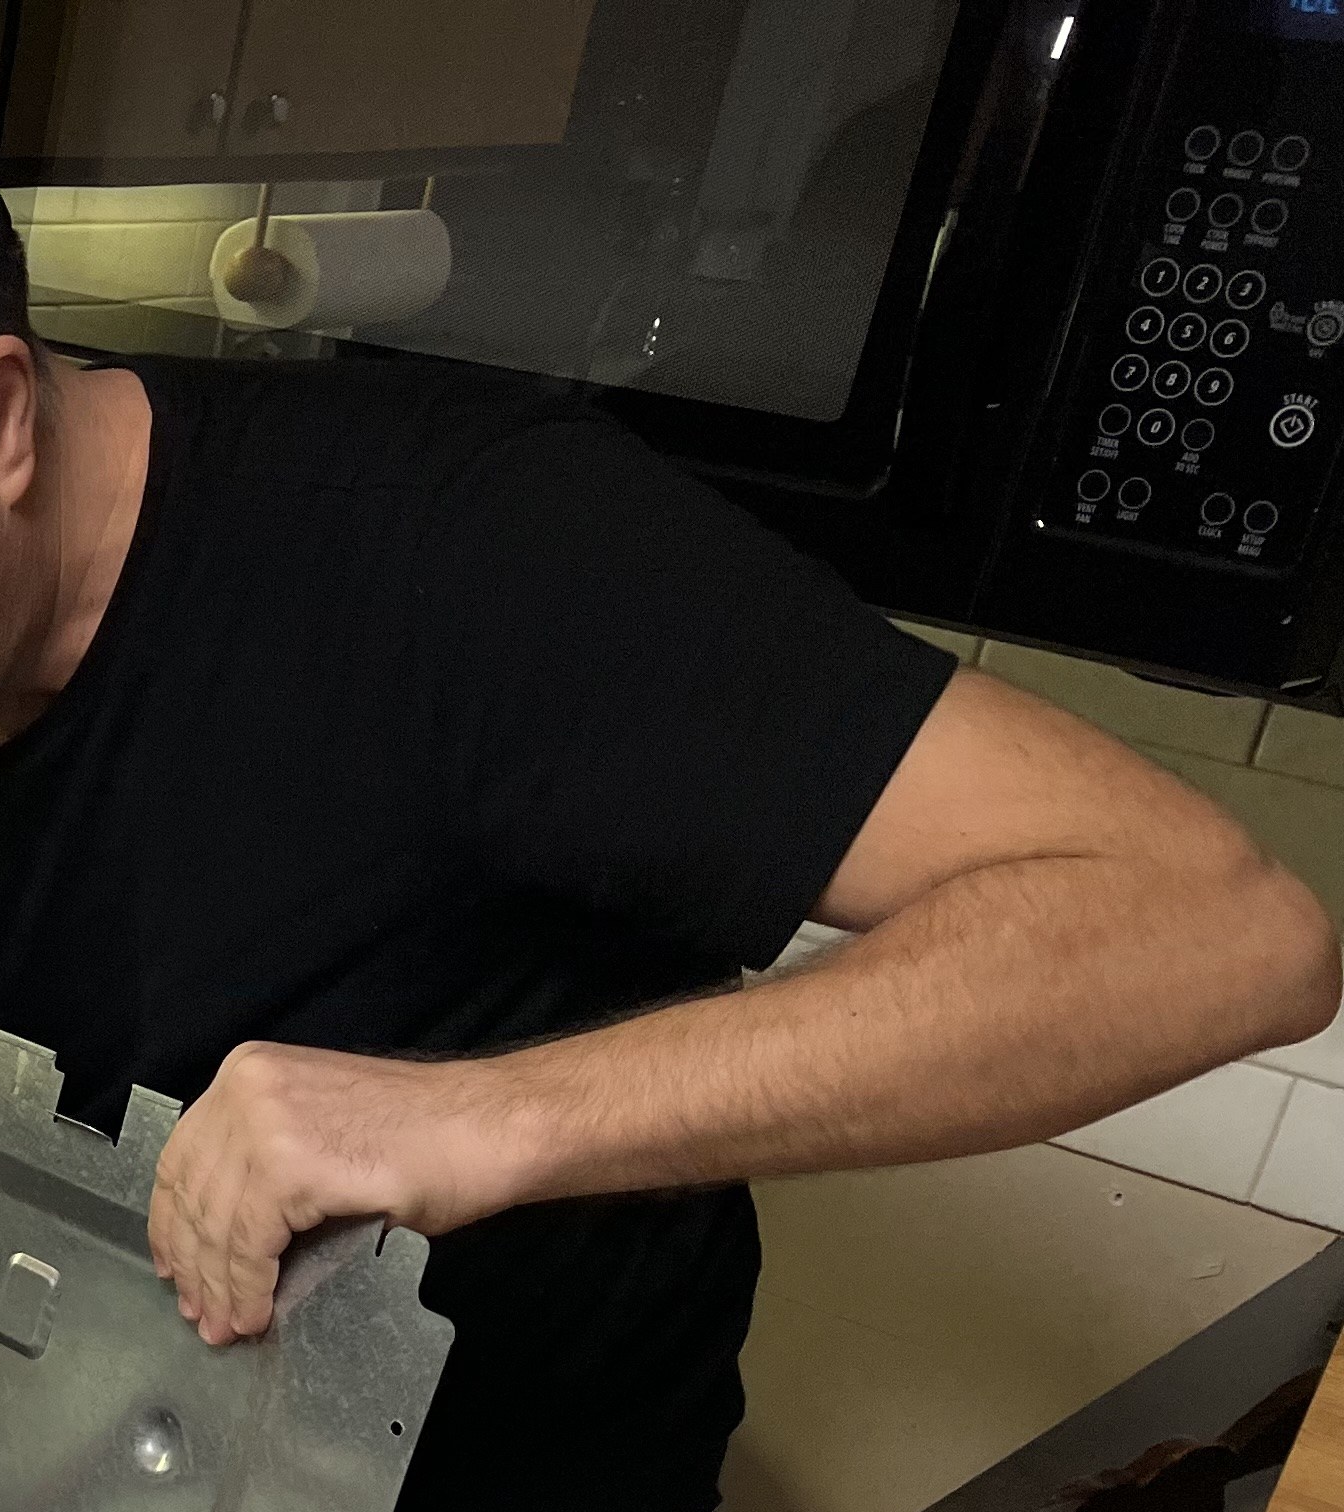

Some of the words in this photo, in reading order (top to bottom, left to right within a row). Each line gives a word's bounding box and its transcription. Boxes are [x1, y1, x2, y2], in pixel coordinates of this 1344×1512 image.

[1157, 270, 1166, 284] 1
[1197, 276, 1209, 291] 2
[1140, 319, 1152, 332] 4
[1181, 325, 1193, 338] 5
[1224, 332, 1237, 345] 6
[1125, 366, 1137, 379] 7
[1166, 373, 1178, 386] 8
[1208, 380, 1220, 394] 9
[1283, 393, 1318, 409] START
[1151, 420, 1162, 434] 0
